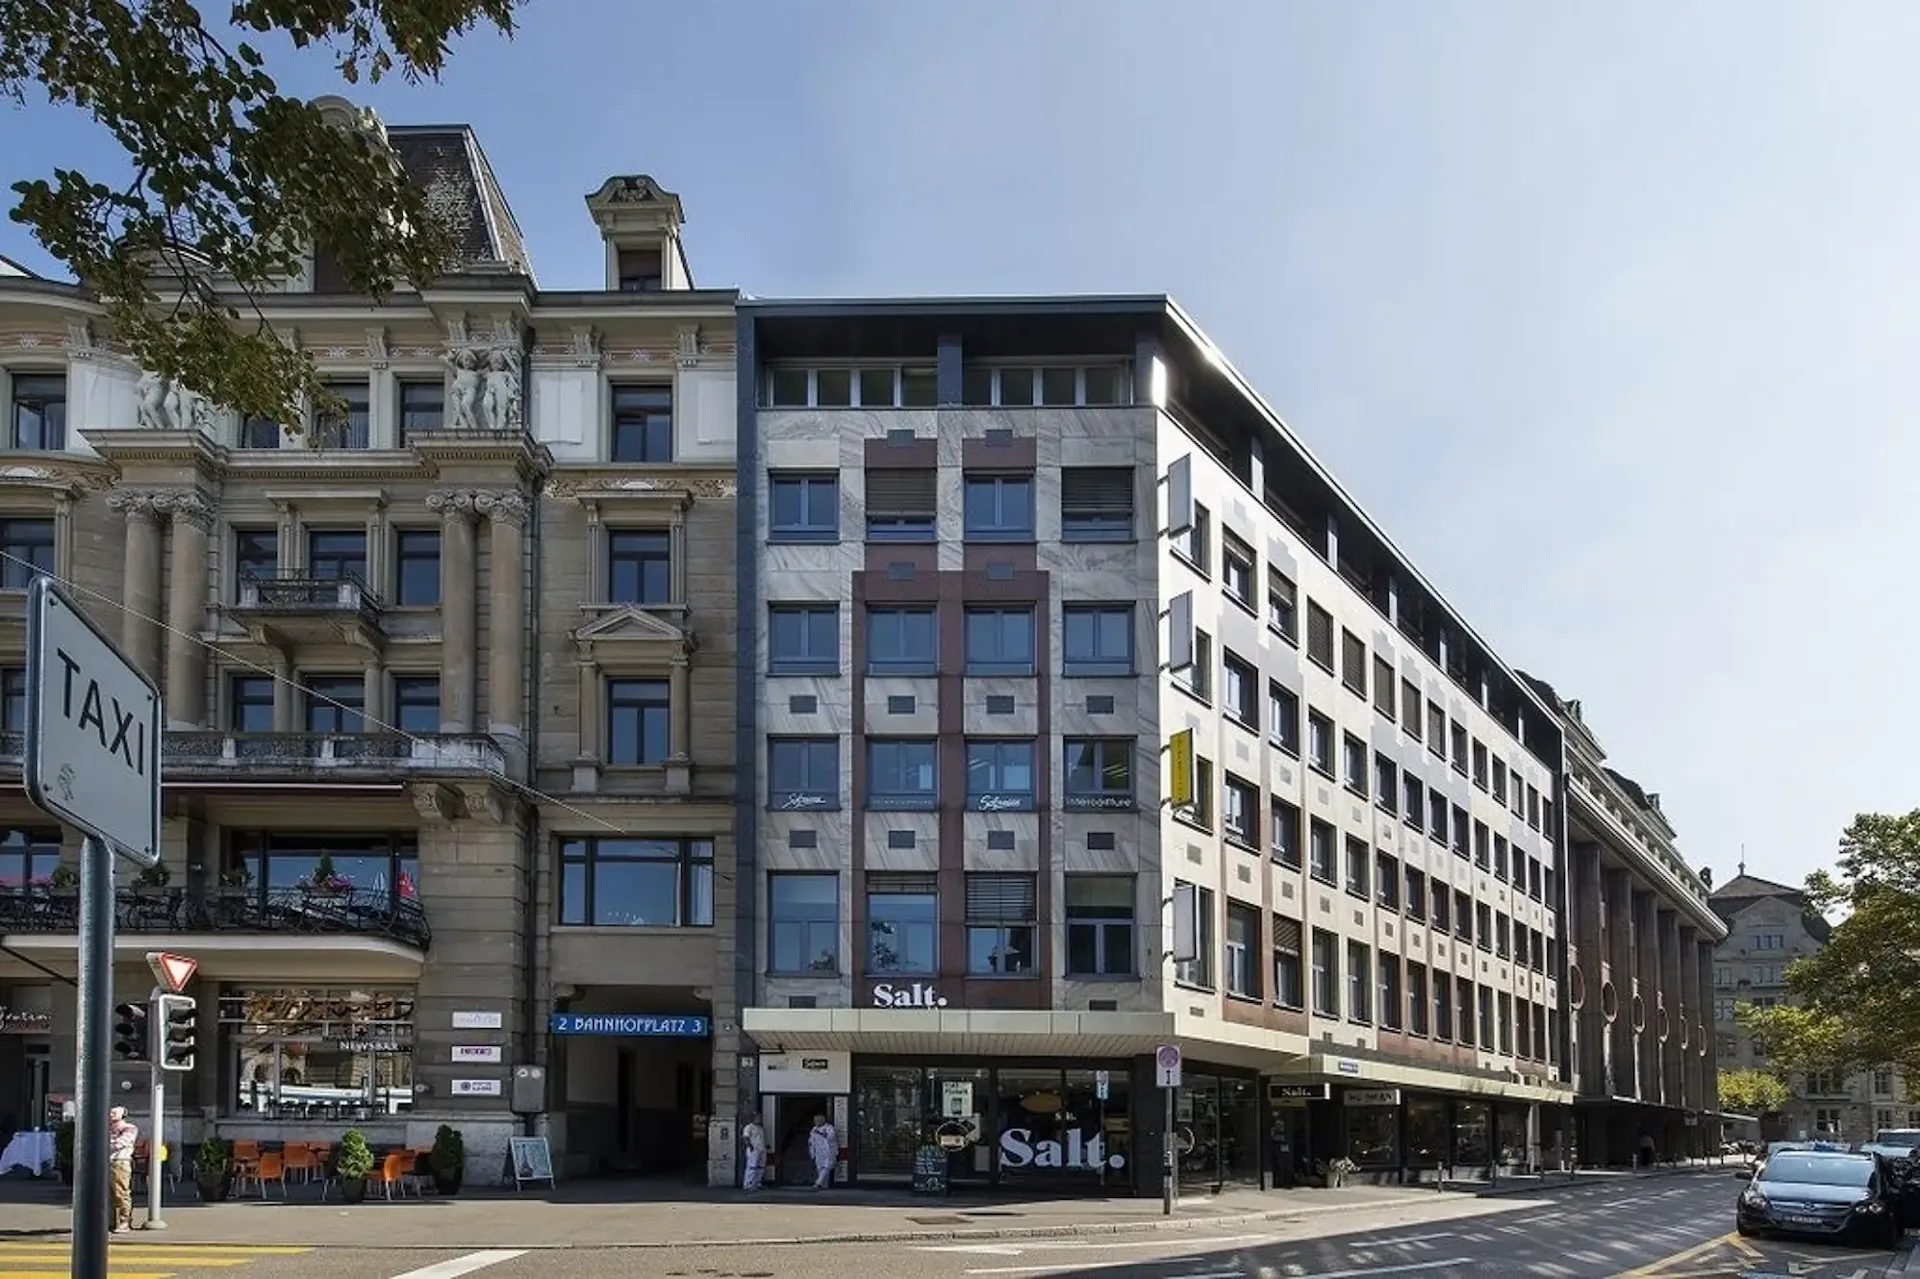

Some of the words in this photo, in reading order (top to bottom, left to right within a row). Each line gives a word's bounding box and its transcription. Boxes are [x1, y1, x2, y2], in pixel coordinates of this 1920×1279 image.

[57, 648, 144, 775] TAXI
[873, 983, 948, 1006] Salt.
[558, 1018, 567, 1031] 2
[574, 1018, 685, 1033] BAHNHOFPLATZ
[692, 1020, 701, 1033] 3
[1000, 1127, 1125, 1168] Salt.
